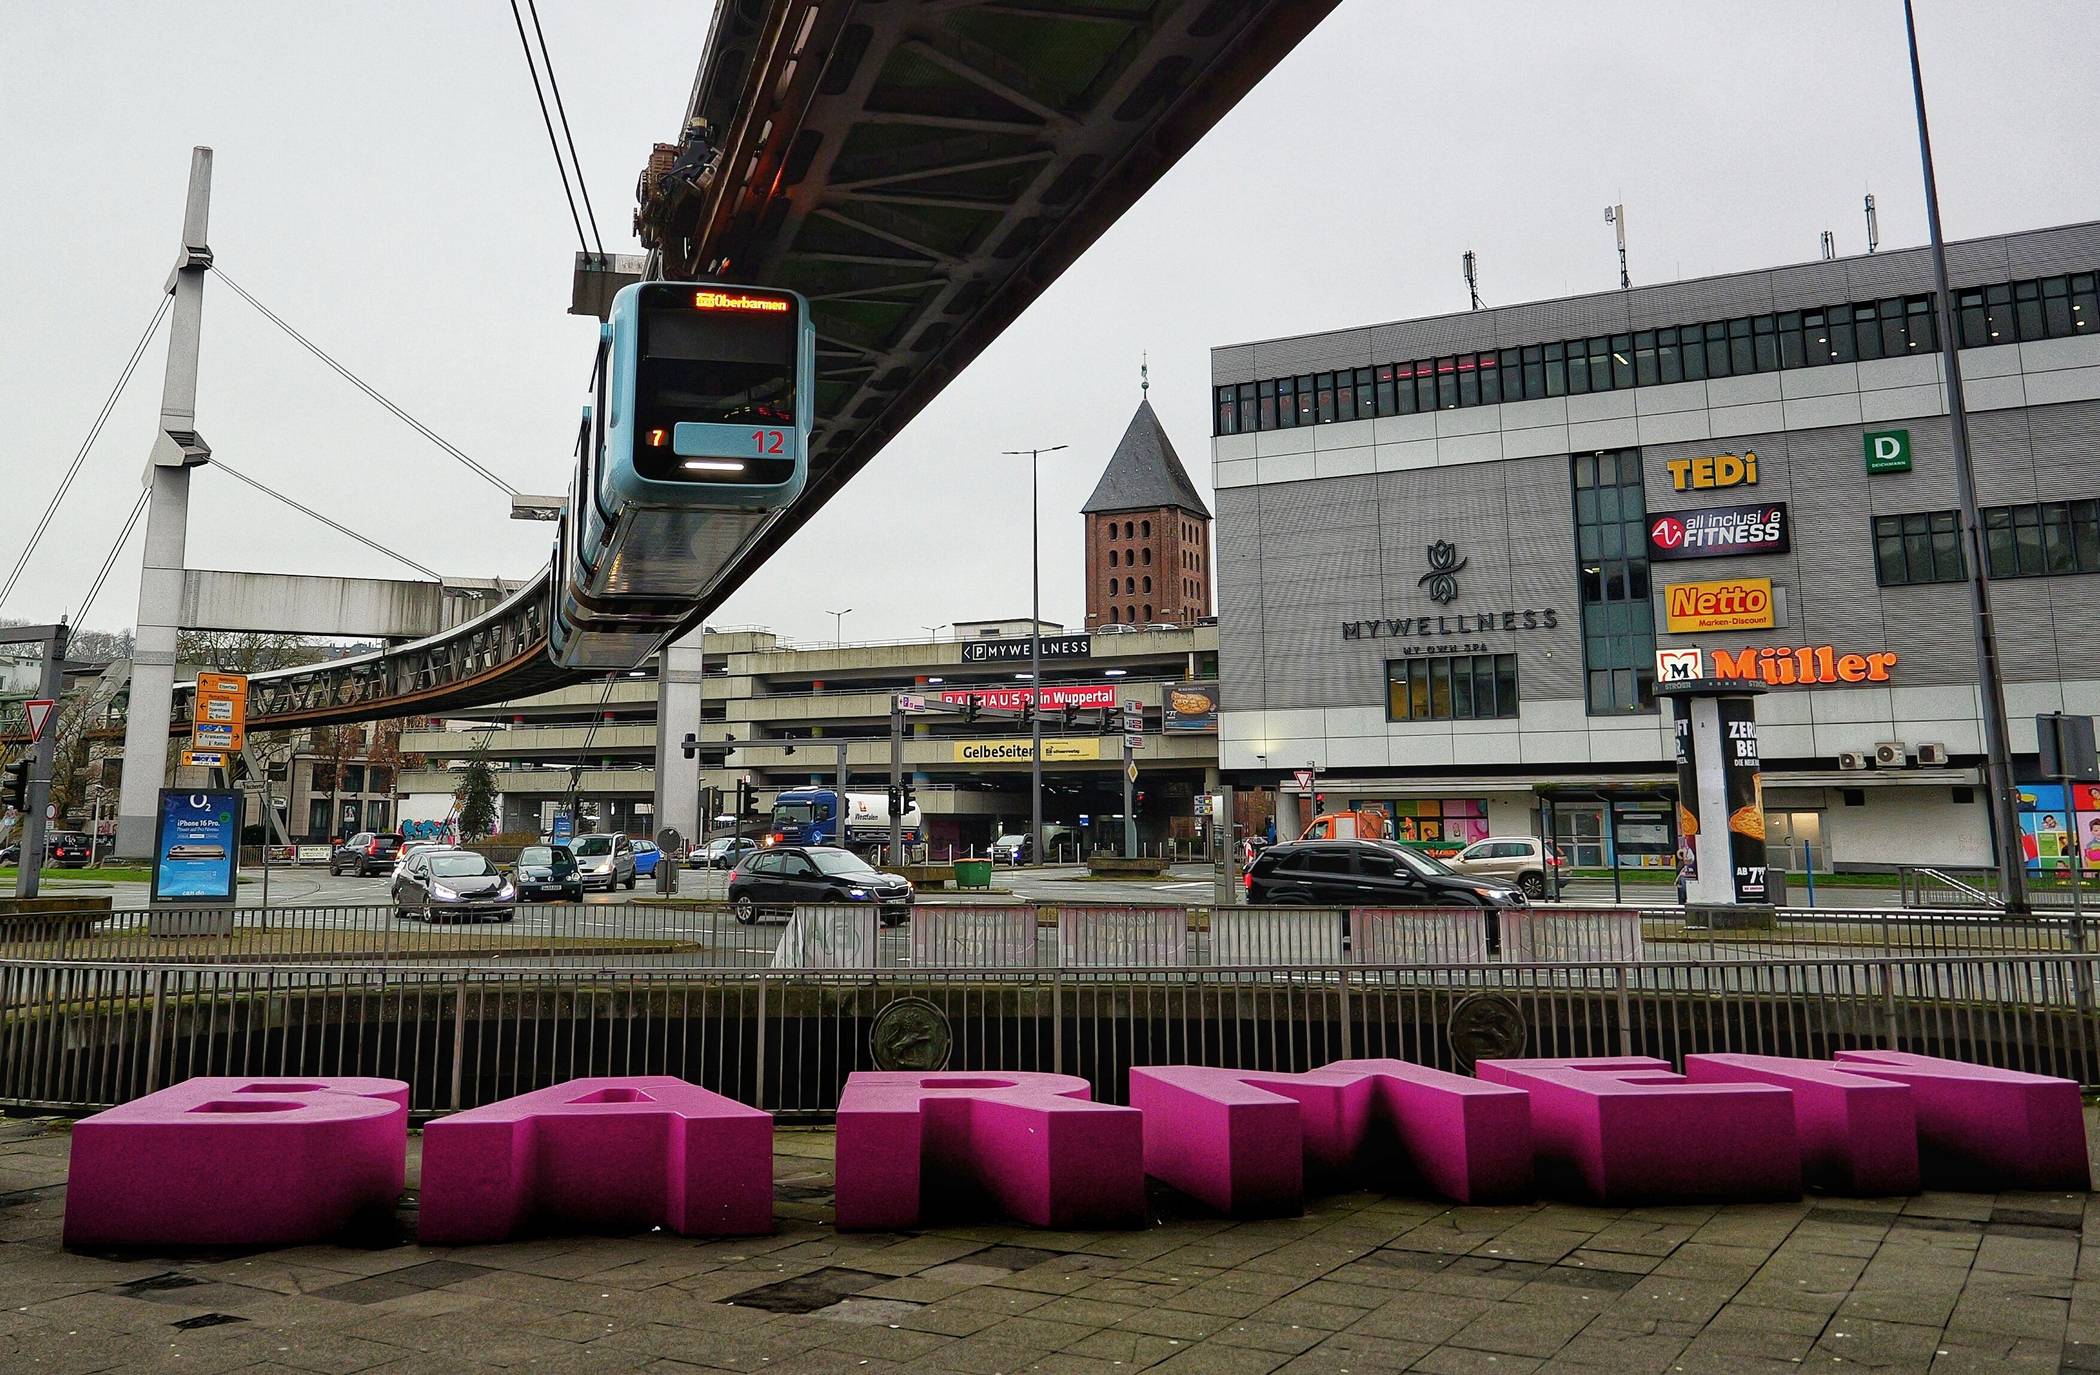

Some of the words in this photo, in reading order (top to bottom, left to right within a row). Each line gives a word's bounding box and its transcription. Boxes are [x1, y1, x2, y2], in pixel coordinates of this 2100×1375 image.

[652, 429, 663, 447] 7
[752, 430, 785, 454] 12
[1874, 436, 1901, 460] D
[1666, 452, 1758, 491] TEDi
[1686, 514, 1704, 529] all
[1709, 507, 1781, 528] inclusive
[1683, 523, 1780, 548] FITNESS
[1671, 586, 1767, 617] Netto
[1342, 607, 1558, 640] MYWELLNESS
[1699, 616, 1767, 627] Marken-Discount
[988, 641, 1088, 657] MYWELNESS
[1403, 646, 1420, 655] MY
[1427, 644, 1457, 654] OWN
[1671, 663, 1689, 679] M
[1711, 646, 1897, 685] Müller
[1039, 691, 1050, 704] in
[1053, 689, 1113, 708] Wuppertal
[177, 819, 199, 827] iPhone
[200, 819, 207, 827] 16
[208, 819, 221, 827] Pro.
[1737, 866, 1748, 876] AB
[63, 1049, 2091, 1254] BARMEN
